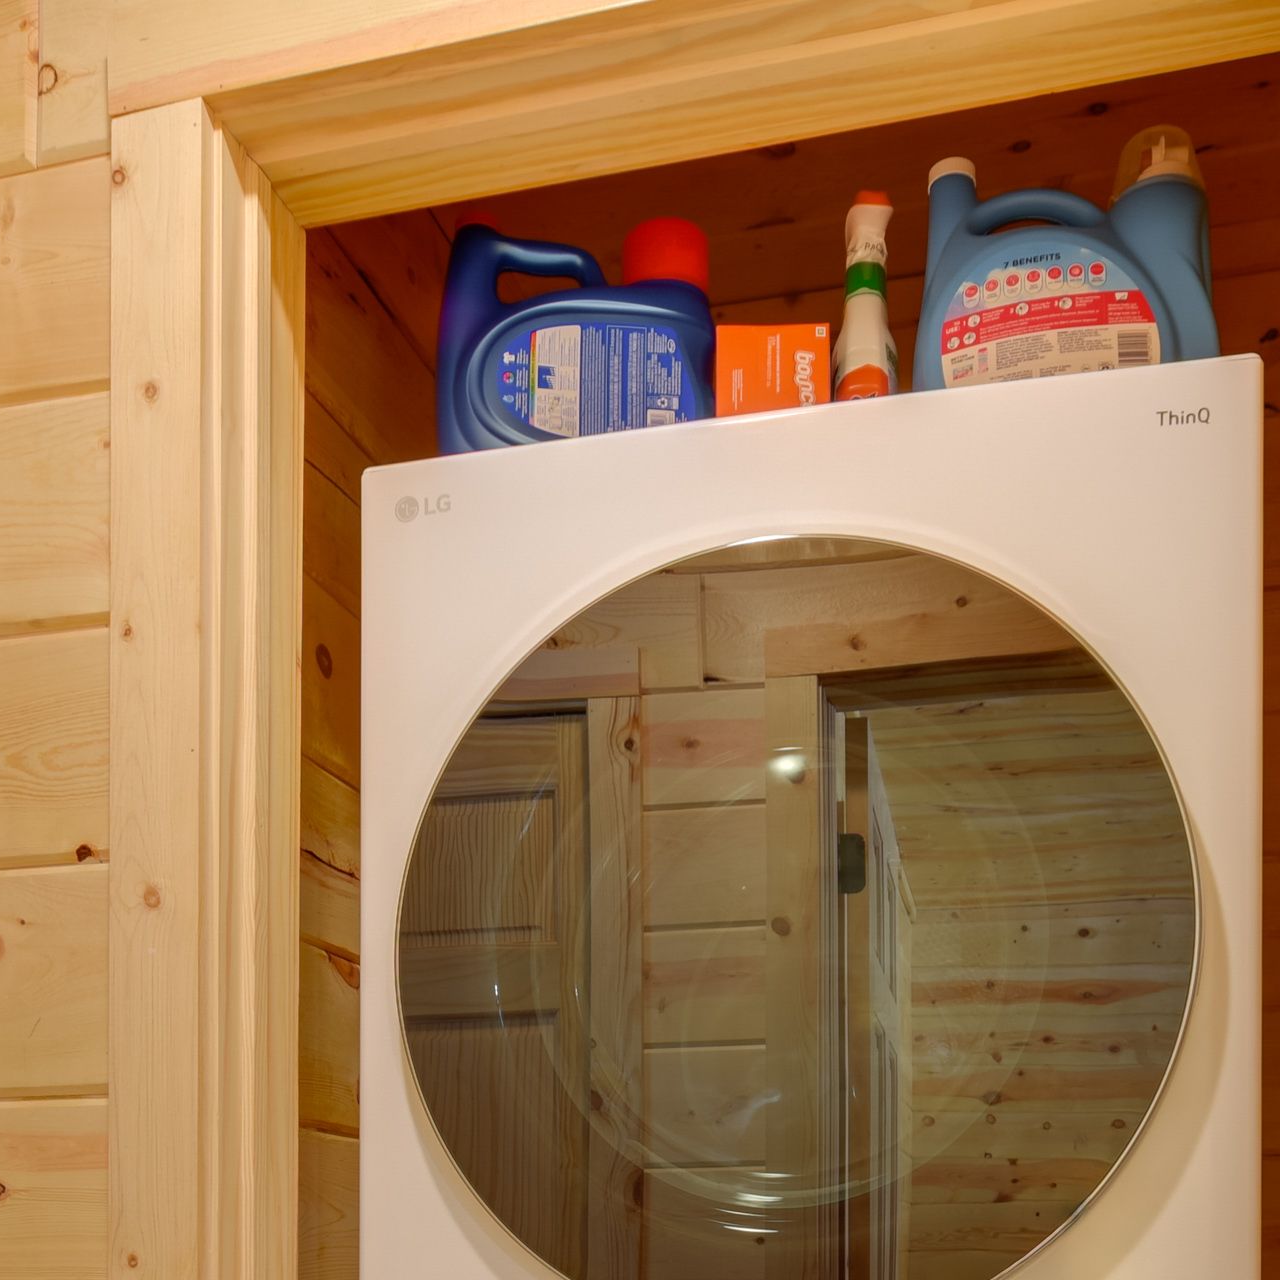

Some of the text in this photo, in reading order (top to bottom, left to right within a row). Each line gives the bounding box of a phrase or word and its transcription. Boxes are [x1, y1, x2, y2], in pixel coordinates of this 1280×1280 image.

[1003, 252, 1061, 269] 7 BENEFITS
[1155, 407, 1210, 426] ThinQ
[423, 494, 452, 516] LG
